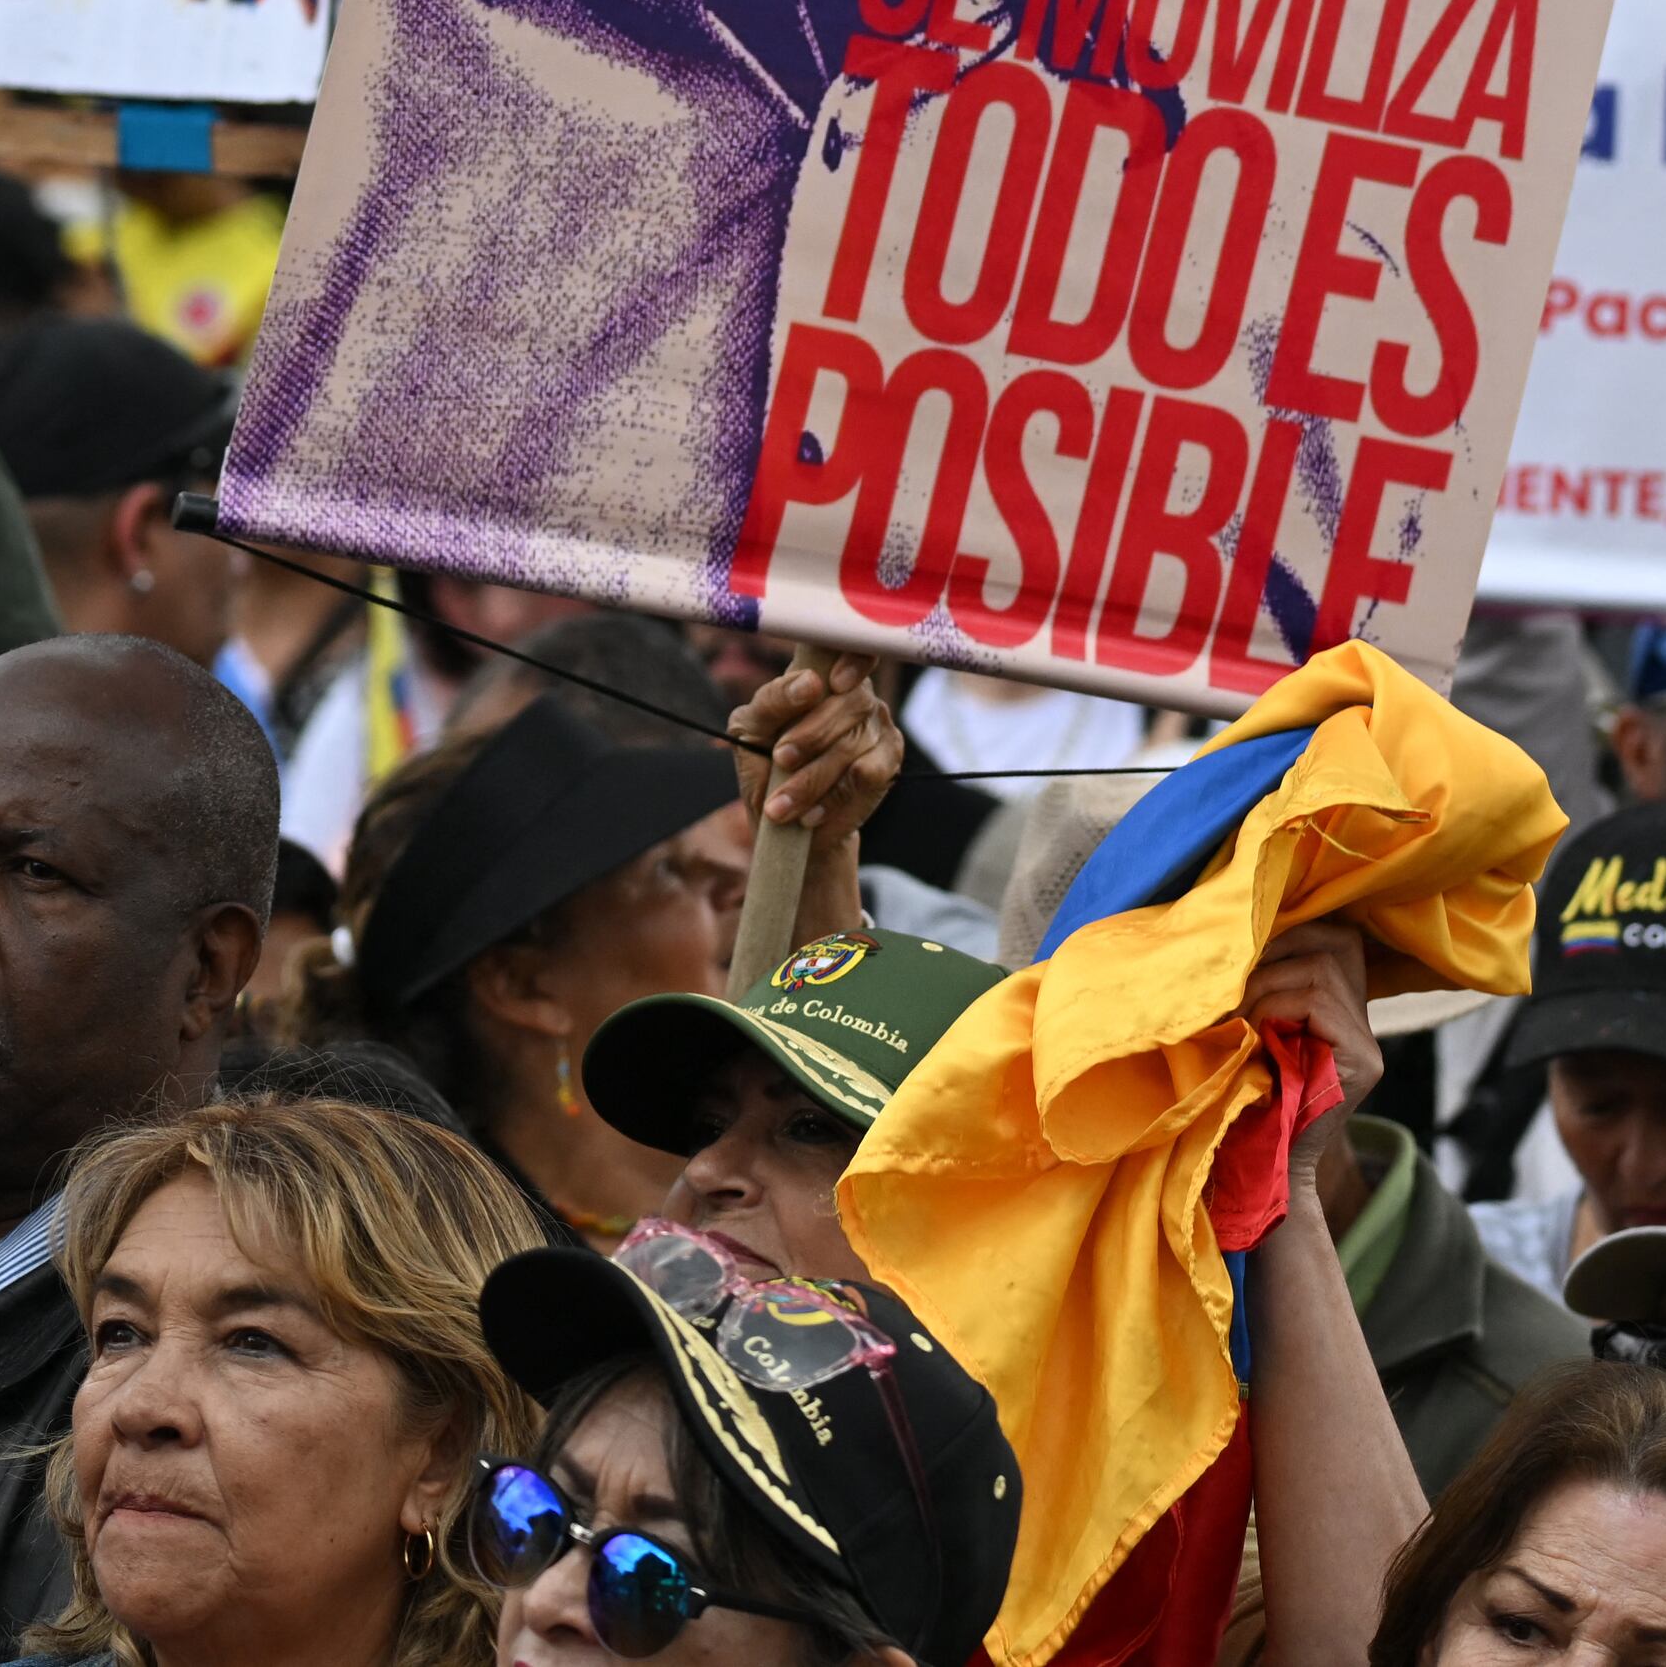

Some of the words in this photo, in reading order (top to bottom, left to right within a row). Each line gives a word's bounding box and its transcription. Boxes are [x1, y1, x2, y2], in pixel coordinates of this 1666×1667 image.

[820, 33, 1278, 392] TODO
[1266, 134, 1512, 439] ES
[729, 321, 1454, 696] POSIBLE
[770, 995, 798, 1015] de
[803, 999, 910, 1054] Colombia
